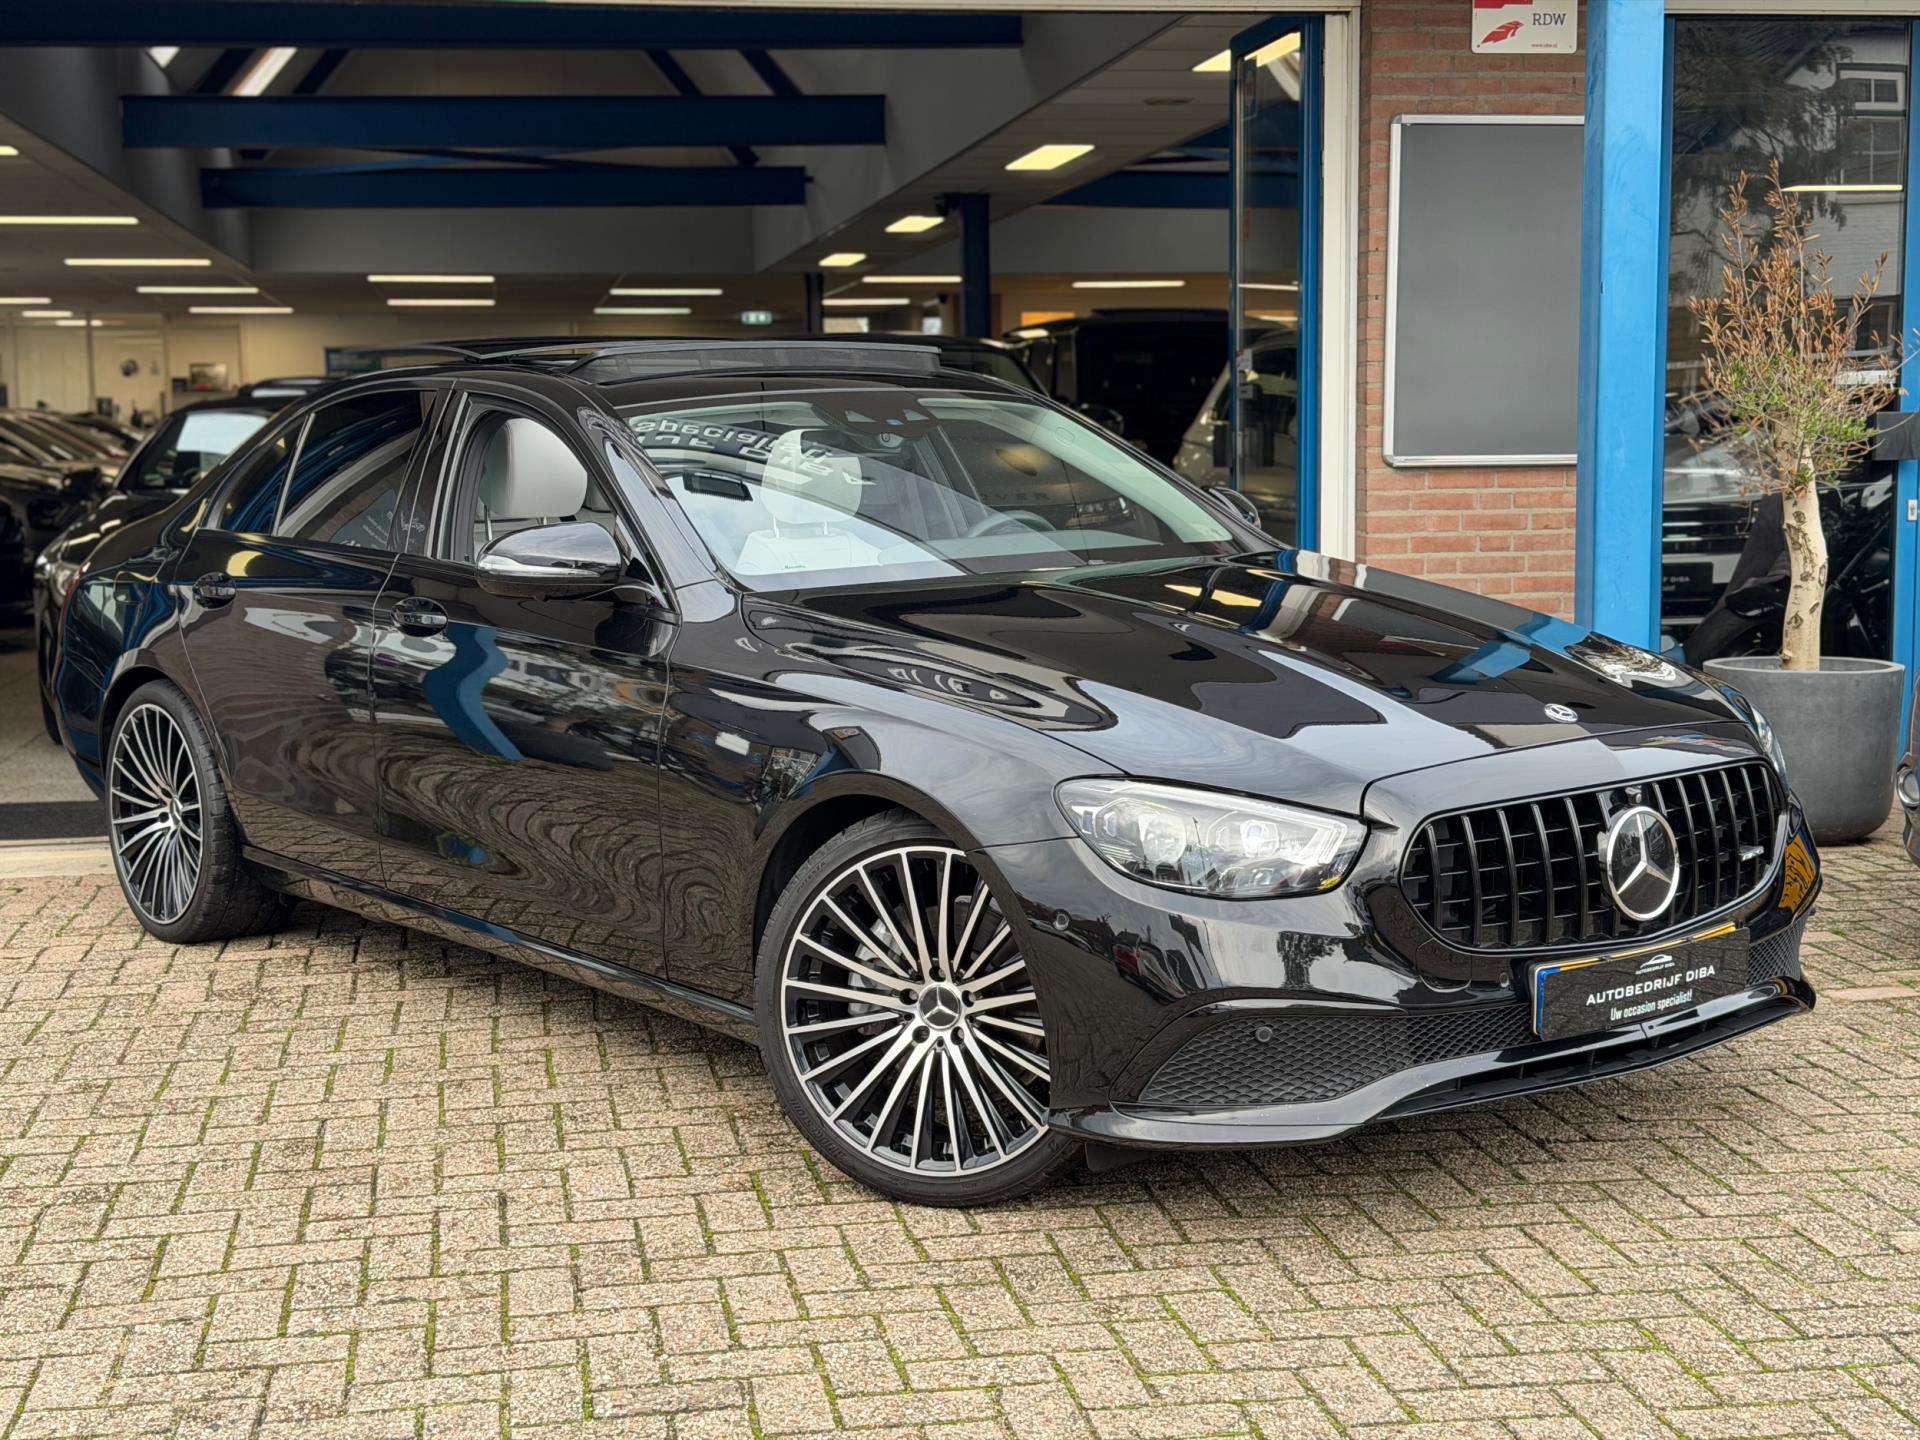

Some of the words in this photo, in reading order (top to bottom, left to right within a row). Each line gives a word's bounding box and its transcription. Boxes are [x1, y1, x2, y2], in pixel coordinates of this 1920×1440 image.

[1531, 12, 1567, 26] RDW
[1585, 974, 1683, 1006] AUTOBEDRIJF
[1685, 965, 1716, 981] DIBA
[1610, 1007, 1622, 1021] Uw
[1623, 1000, 1656, 1018] occasion
[1657, 989, 1693, 1011] specialist!
